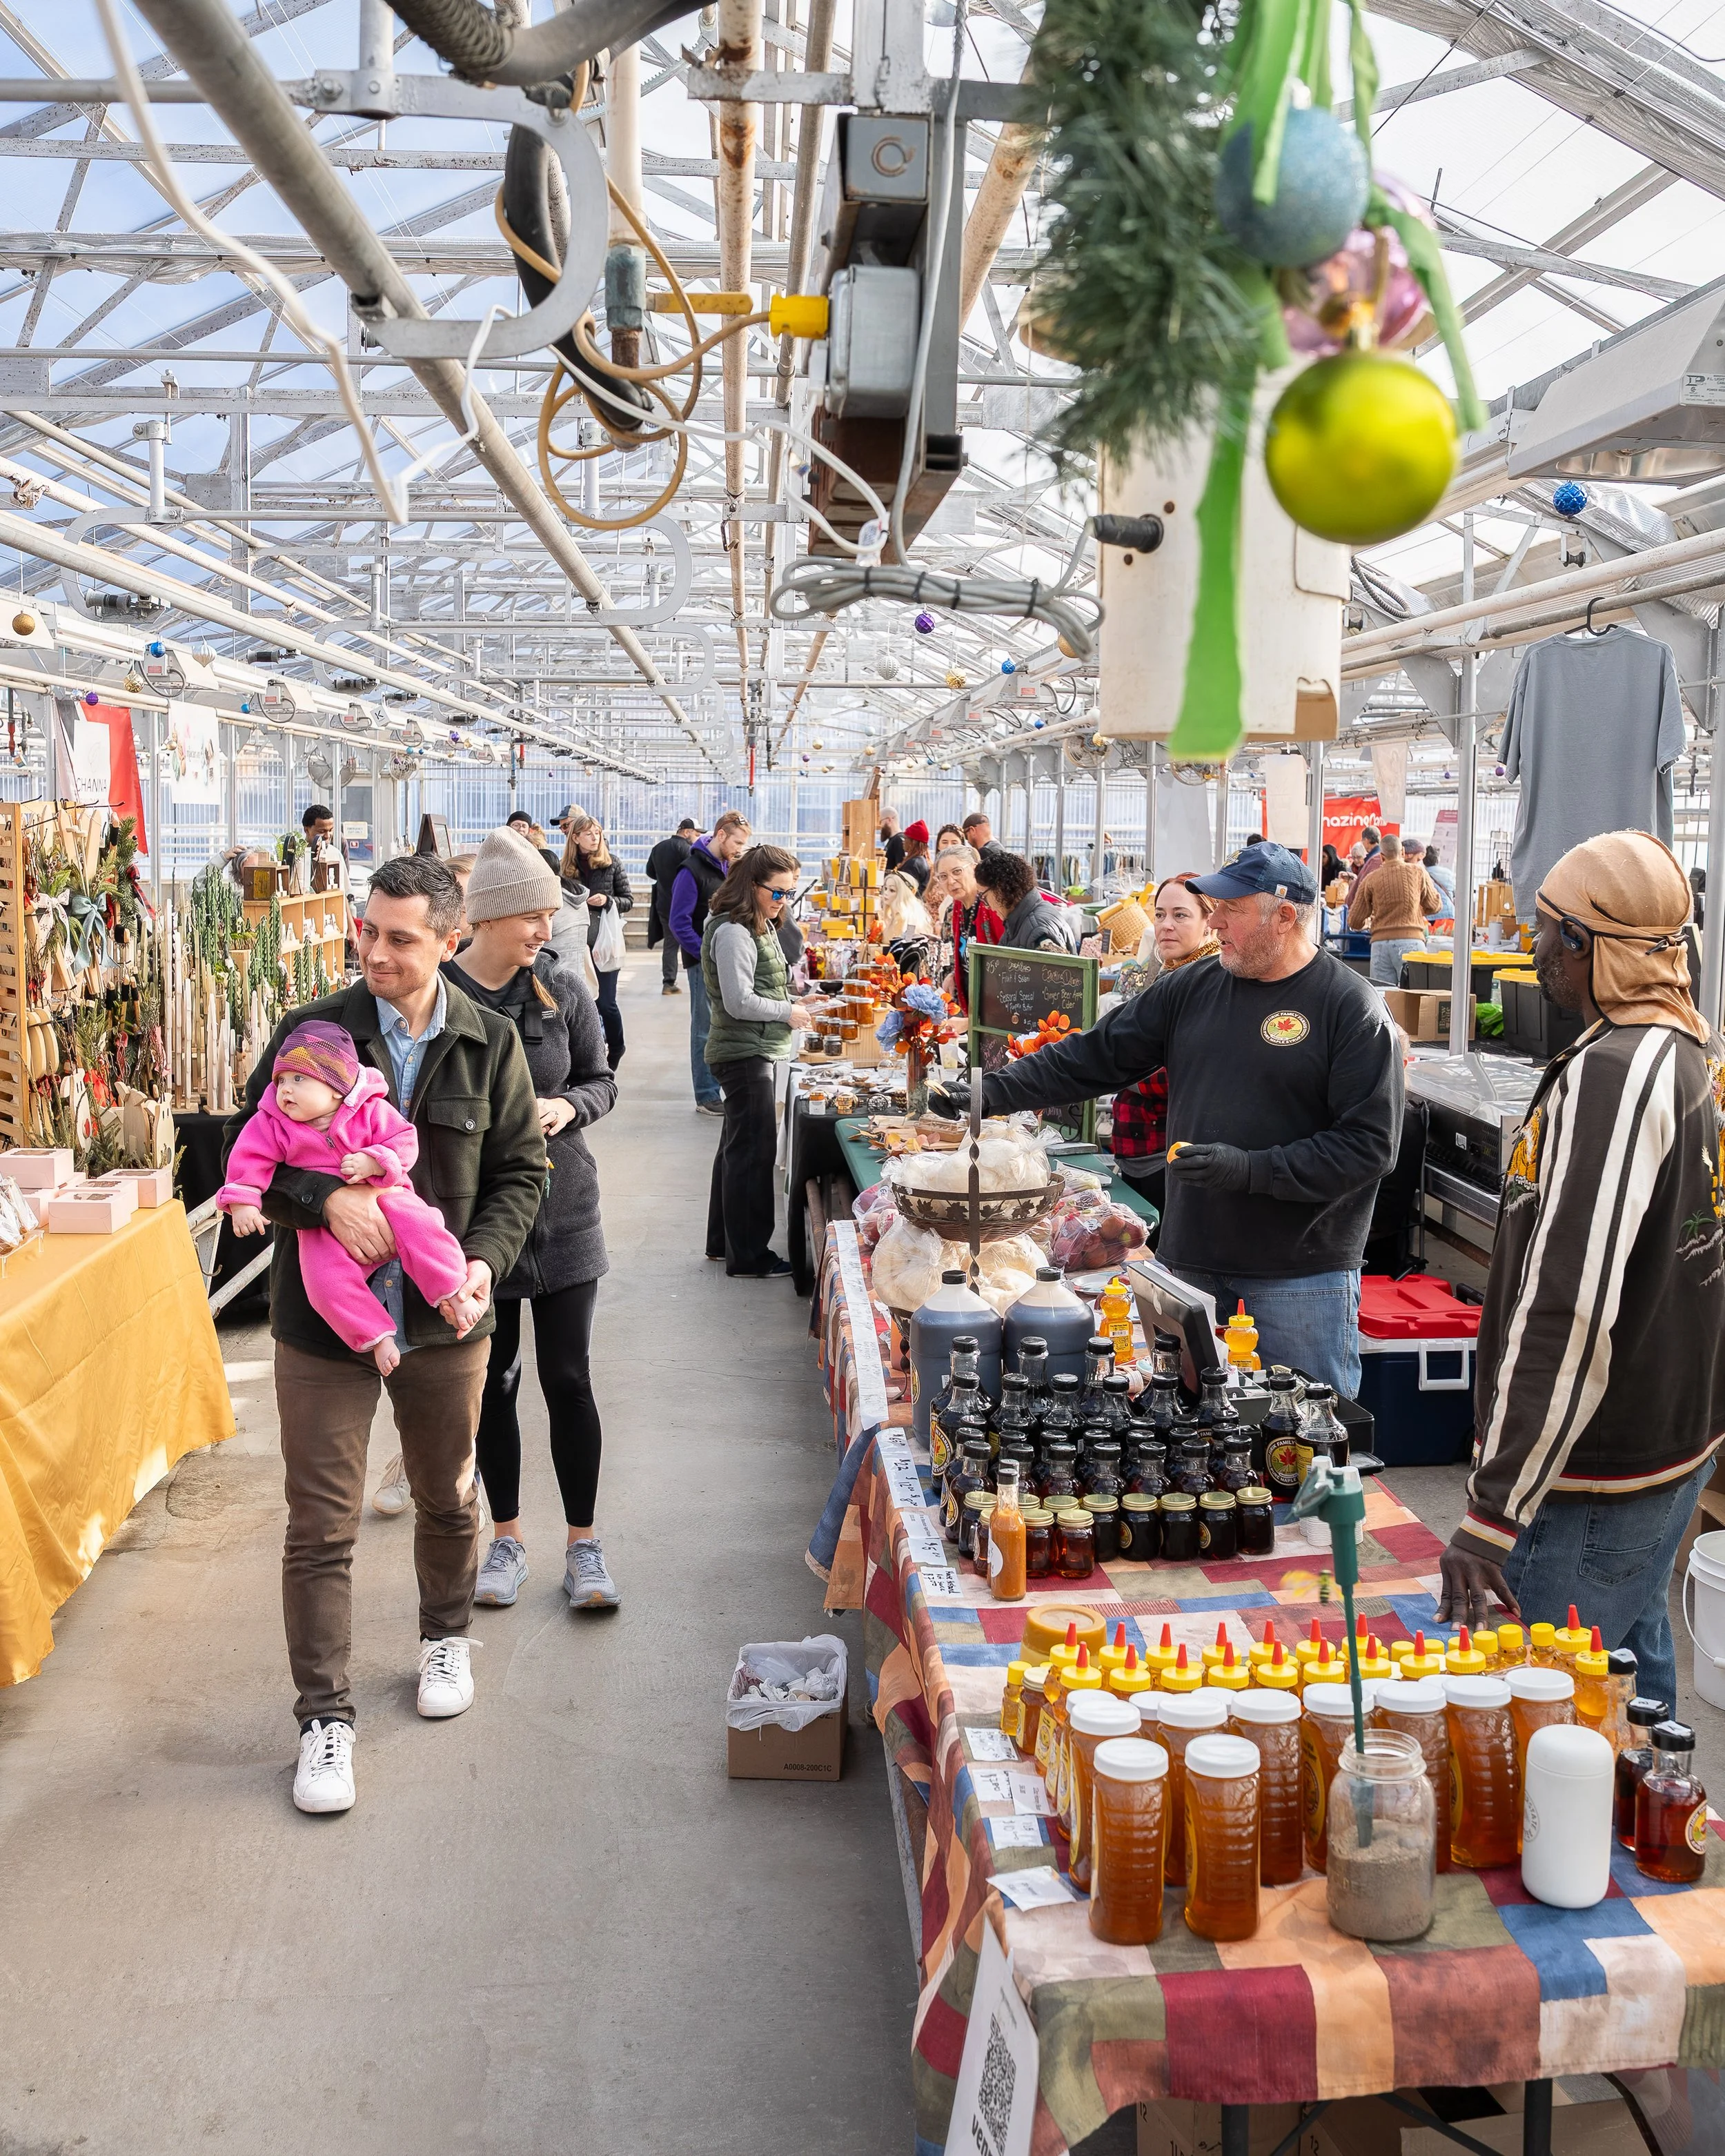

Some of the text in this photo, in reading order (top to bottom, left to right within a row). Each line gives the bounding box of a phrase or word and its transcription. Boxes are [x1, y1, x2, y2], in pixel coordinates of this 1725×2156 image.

[375, 710, 384, 720] K
[1061, 989, 1072, 999] Beer
[1285, 1036, 1302, 1044] SYRUP
[783, 1763, 832, 1772] A0008-200C1C
